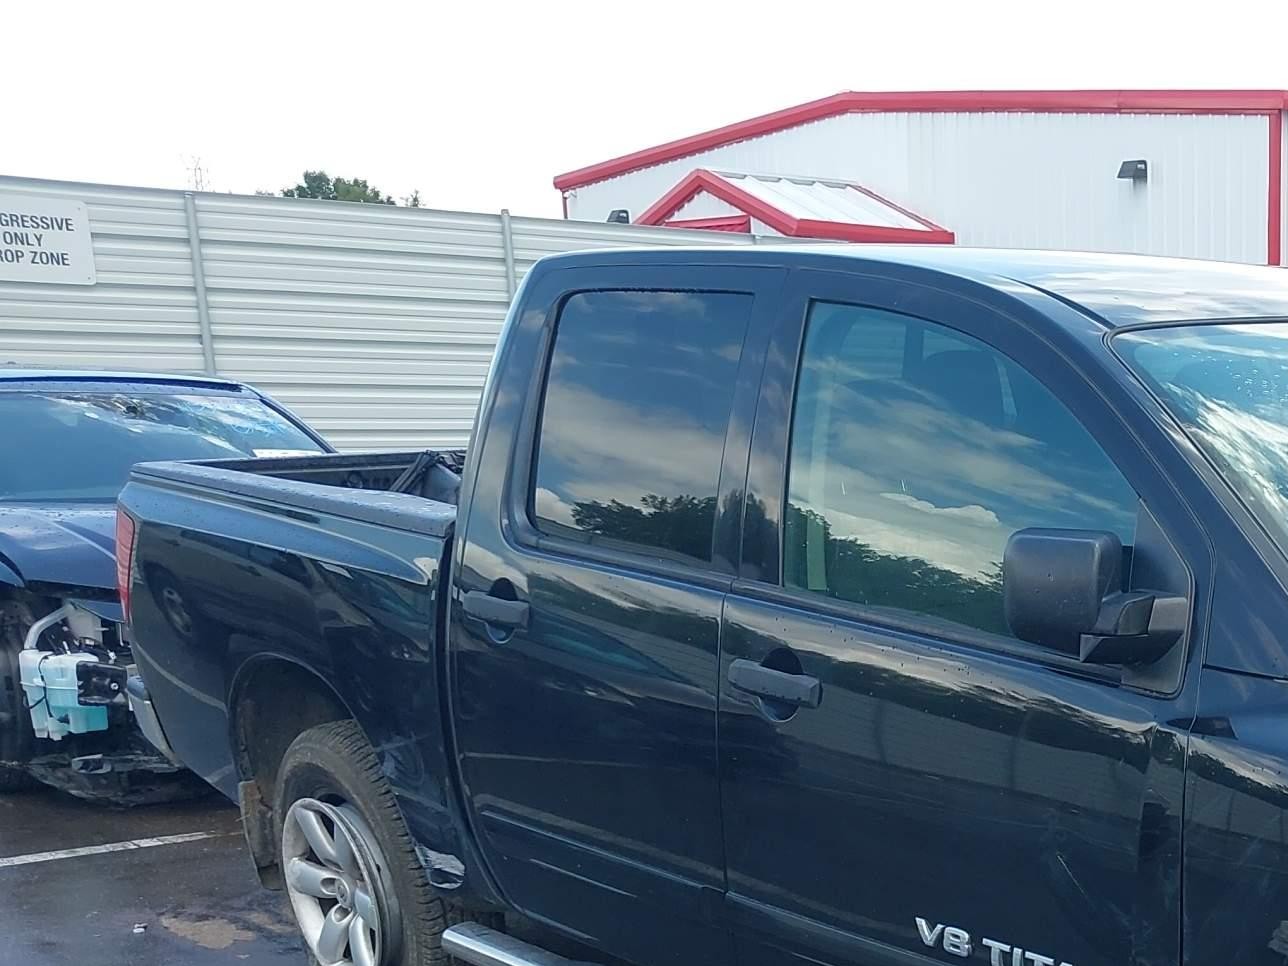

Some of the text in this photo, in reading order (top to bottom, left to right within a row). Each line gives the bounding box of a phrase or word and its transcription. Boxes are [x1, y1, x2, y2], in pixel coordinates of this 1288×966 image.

[0, 213, 74, 232] GRESSIVE
[3, 231, 43, 247] ONLY
[29, 251, 70, 266] ZONE
[915, 917, 971, 957] V8
